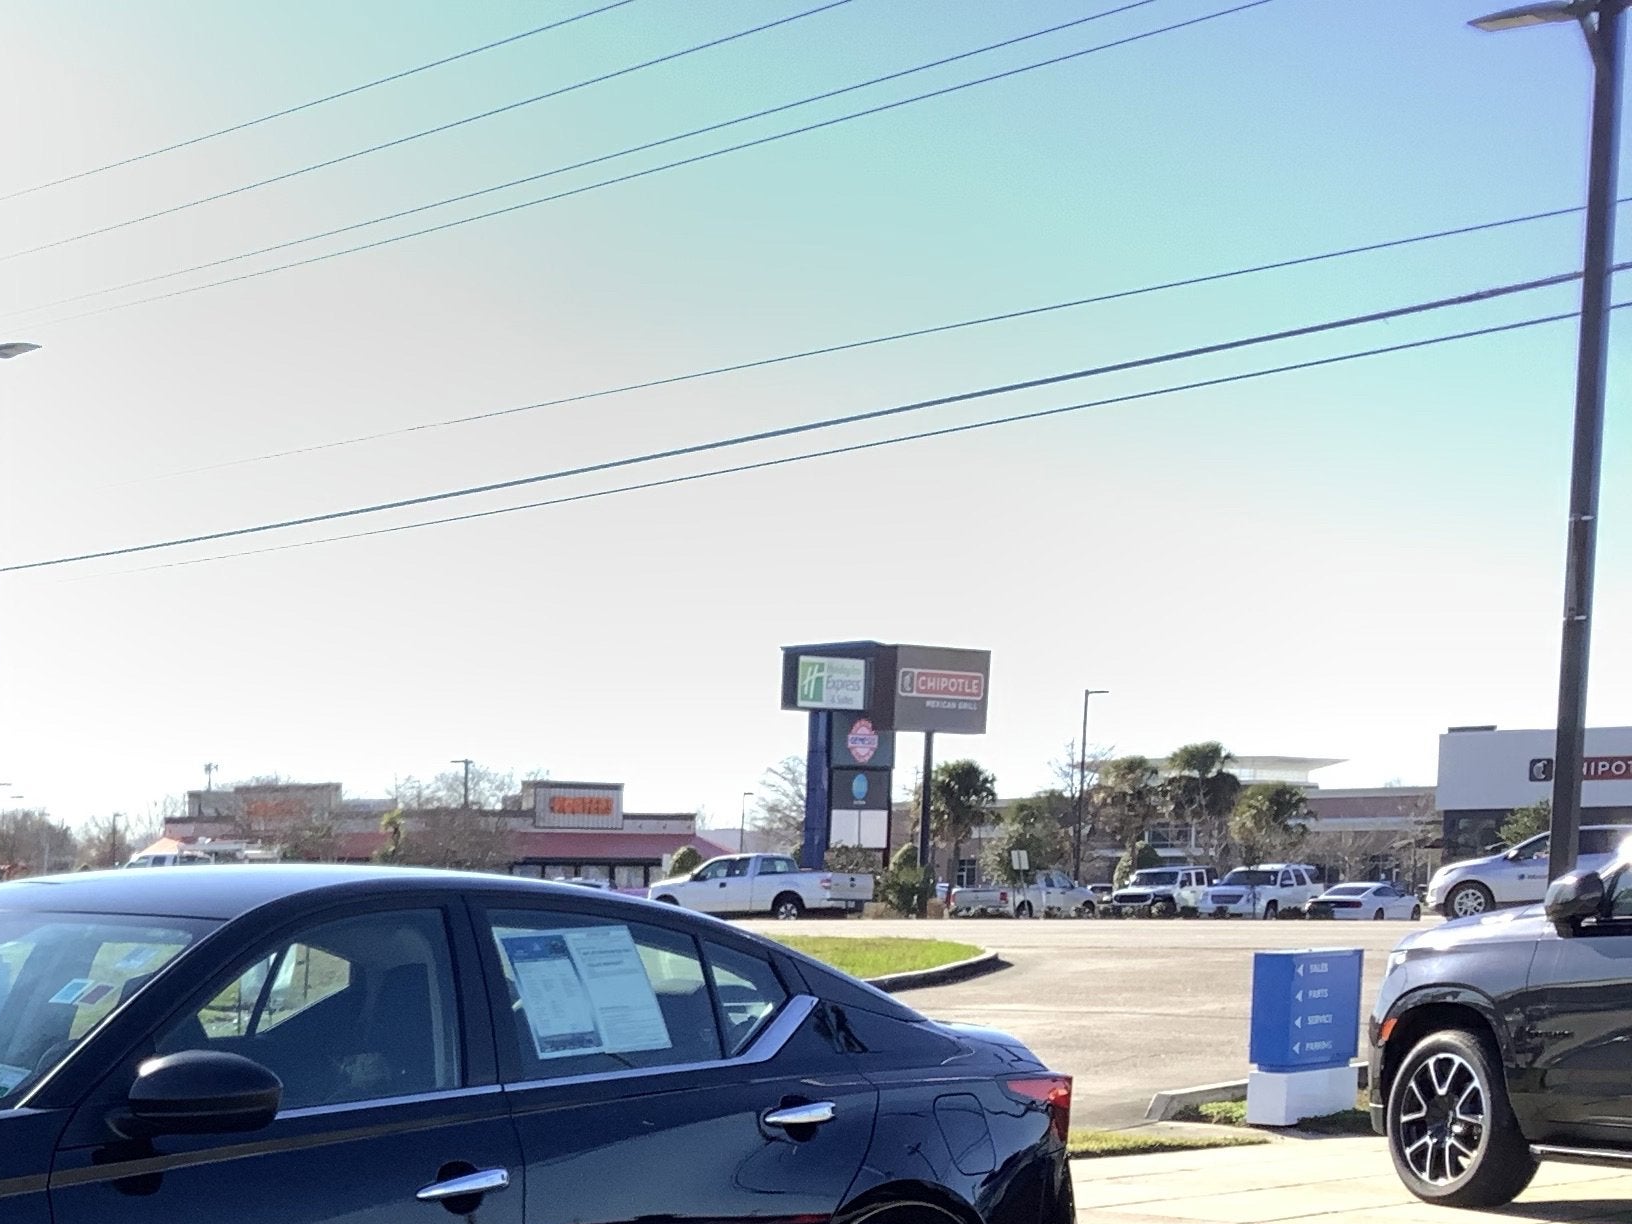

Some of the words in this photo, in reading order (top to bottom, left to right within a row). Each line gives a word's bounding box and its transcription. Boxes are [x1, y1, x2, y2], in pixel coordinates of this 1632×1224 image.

[826, 674, 862, 692] Express
[918, 676, 980, 694] CHIPOTLE
[925, 700, 957, 709] MEXICAN
[1309, 963, 1329, 974] SALES
[1308, 988, 1329, 999] PARTS
